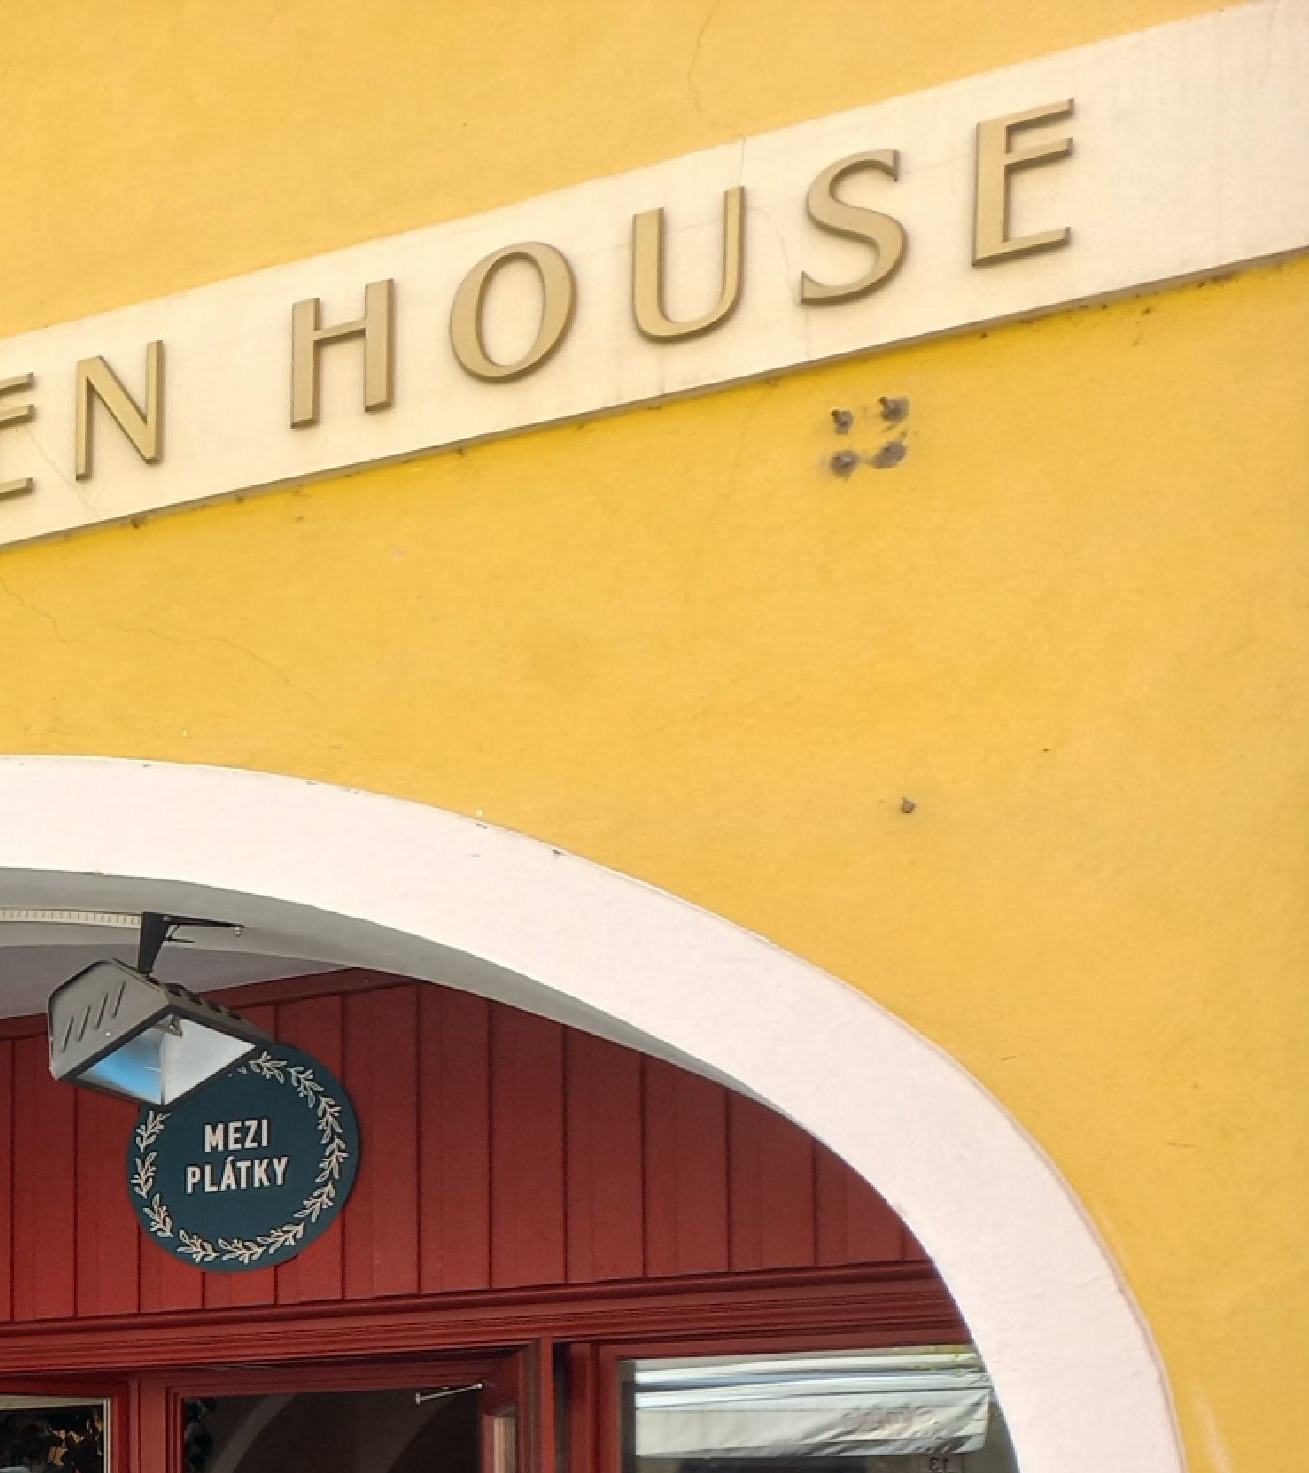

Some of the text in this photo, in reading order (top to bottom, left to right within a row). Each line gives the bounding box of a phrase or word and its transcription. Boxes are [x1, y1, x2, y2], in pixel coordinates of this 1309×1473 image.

[291, 96, 1074, 430] HOUSE
[203, 1118, 269, 1153] MEZI
[185, 1156, 289, 1195] PLÁTKY
